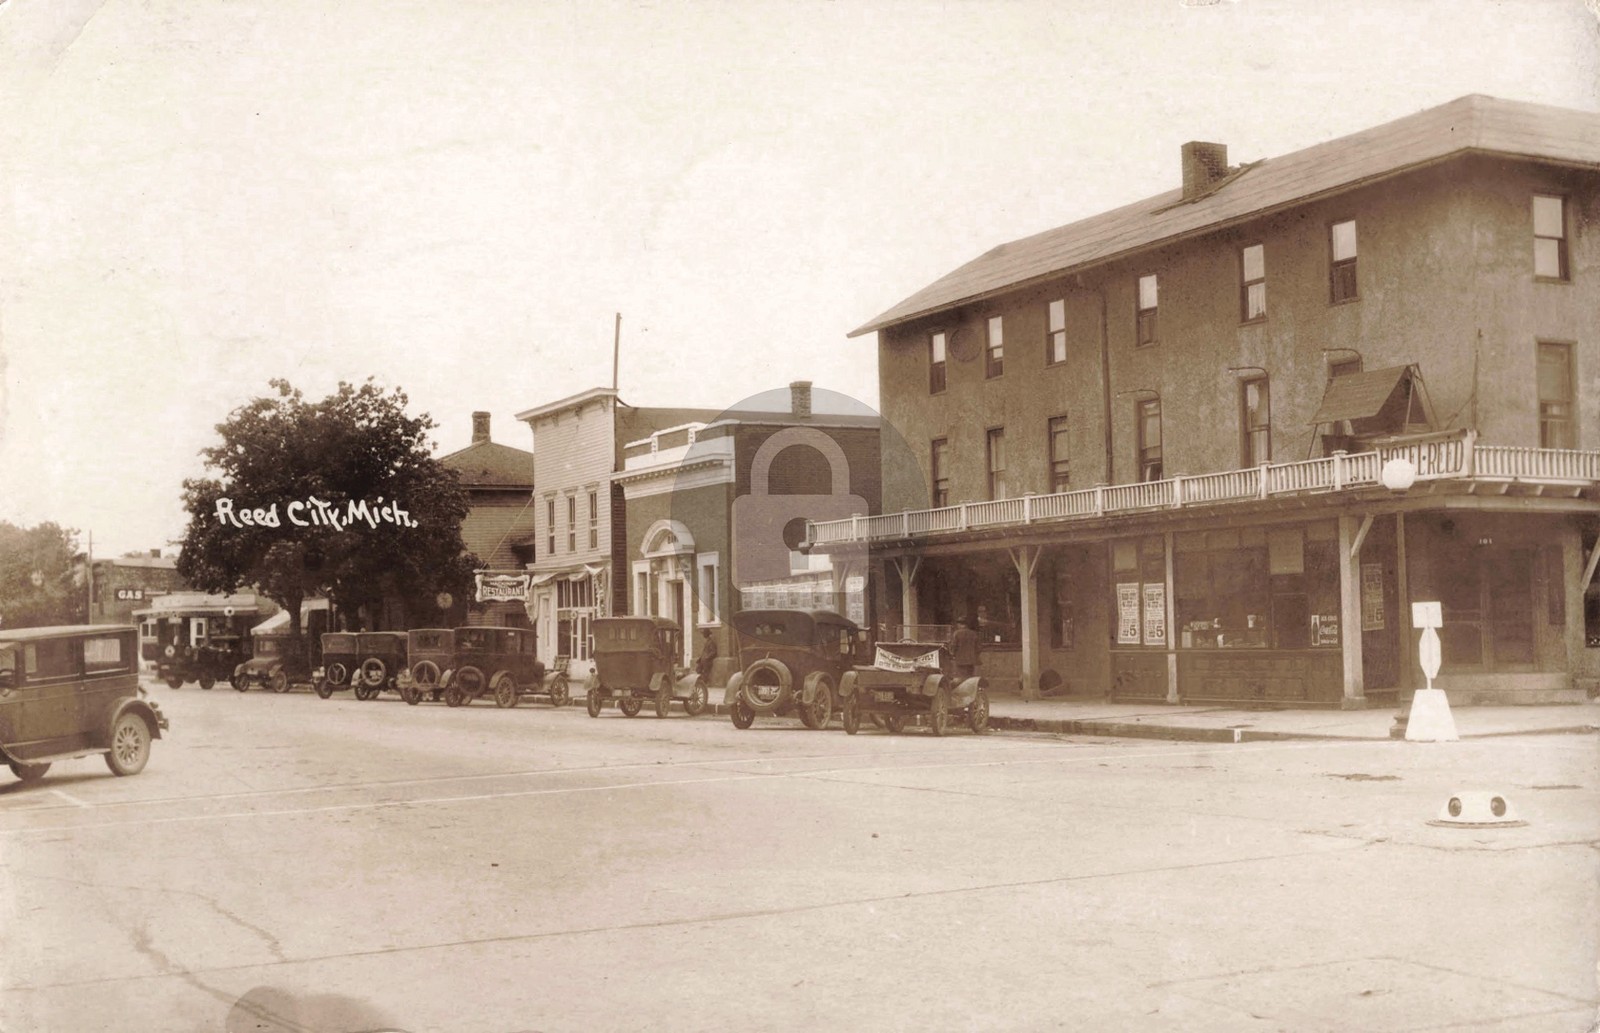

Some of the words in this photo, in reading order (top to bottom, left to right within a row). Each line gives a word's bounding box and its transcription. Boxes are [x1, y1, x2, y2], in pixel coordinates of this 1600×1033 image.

[1427, 439, 1464, 475] REED
[118, 590, 143, 600] GAS
[482, 585, 525, 597] RESTAURANT
[1130, 624, 1137, 637] 5
[1156, 625, 1164, 638] 5
